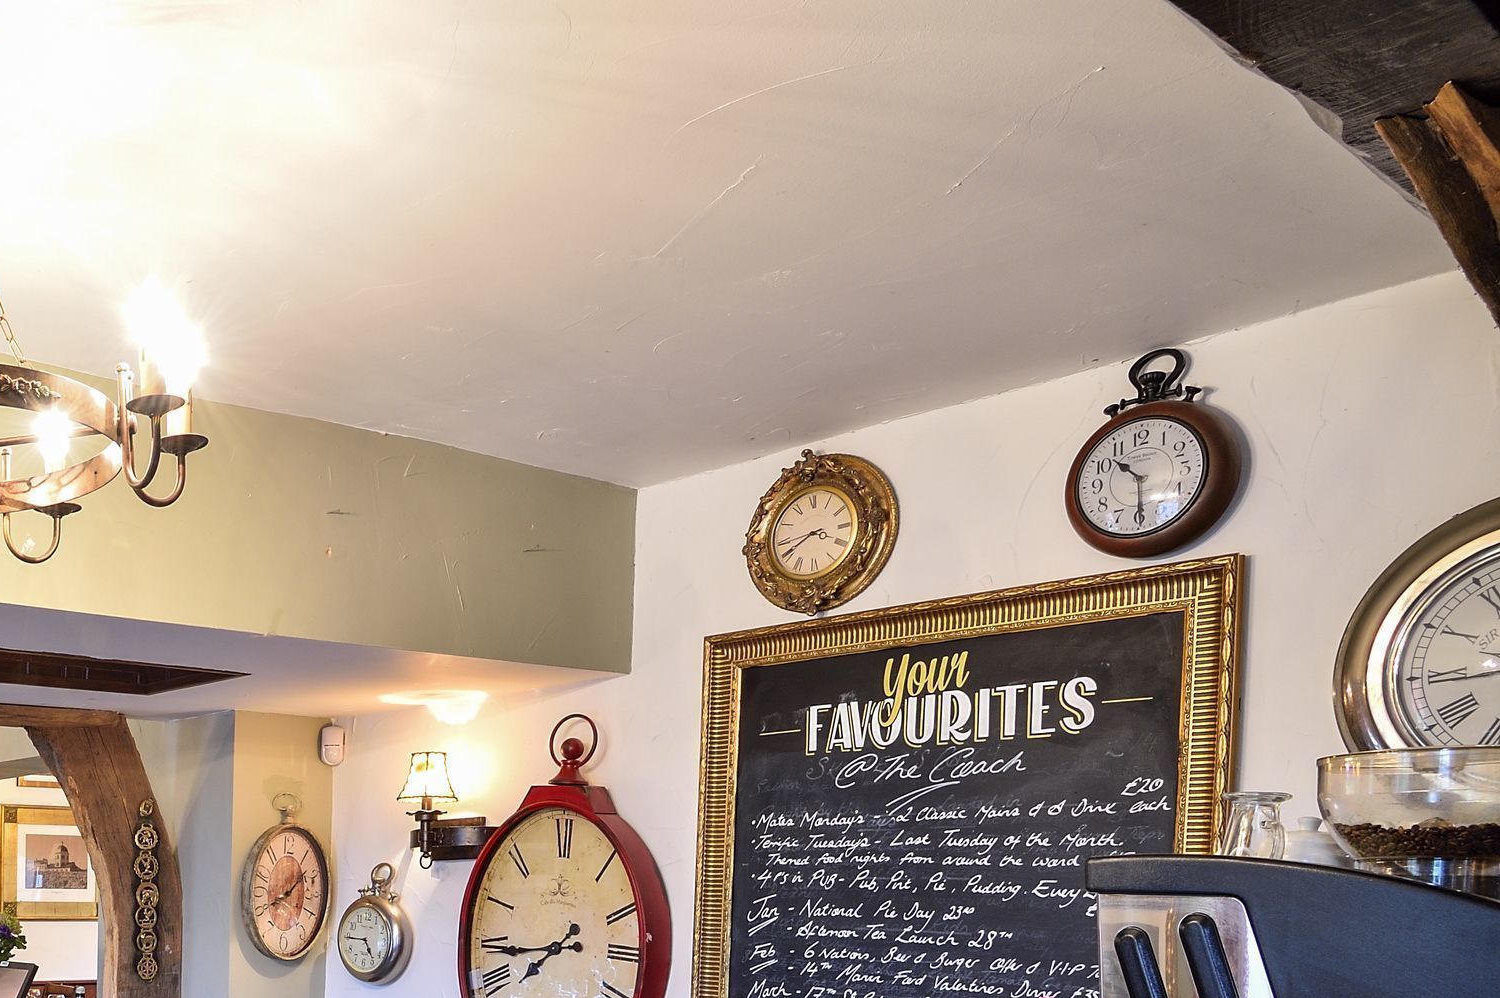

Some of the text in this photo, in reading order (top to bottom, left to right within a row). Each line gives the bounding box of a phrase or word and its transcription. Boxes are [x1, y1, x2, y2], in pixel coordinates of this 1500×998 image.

[1113, 440, 1124, 457] 11
[1133, 429, 1150, 447] 12
[1096, 457, 1112, 475] 10
[1091, 478, 1104, 495] 9
[1097, 496, 1108, 513] 8
[1113, 508, 1125, 524] 7
[805, 676, 1098, 756] FAVOURITES
[874, 753, 922, 783] The
[928, 746, 1027, 783] Coach
[1120, 776, 1165, 797] £20
[755, 811, 795, 834] Mates
[915, 806, 967, 822] Classic
[974, 804, 1020, 825] Mains
[1071, 798, 1117, 817] Drink
[1128, 795, 1172, 814] each
[889, 829, 931, 847] Last
[938, 829, 999, 855] Tuesday
[1003, 834, 1021, 850] of
[1026, 833, 1051, 848] the
[765, 853, 810, 867] Themed
[815, 852, 844, 866] food
[849, 851, 890, 870] nights
[899, 851, 934, 866] from
[942, 854, 992, 866] around
[998, 854, 1023, 868] the
[757, 869, 772, 889] 4
[791, 870, 804, 884] in
[1031, 879, 1082, 908] Every
[746, 893, 781, 923] Jan
[798, 896, 864, 919] National
[873, 900, 899, 918] Pie
[902, 901, 936, 934] Day
[795, 920, 859, 940] Afternoon
[863, 923, 887, 940] Tea
[894, 924, 960, 946] Launch
[748, 942, 776, 961] Feb
[803, 940, 820, 958] 6
[929, 951, 981, 972] Burger
[989, 956, 1024, 974] Offer
[933, 974, 1004, 994] Valentines
[1010, 979, 1061, 998] Dinner
